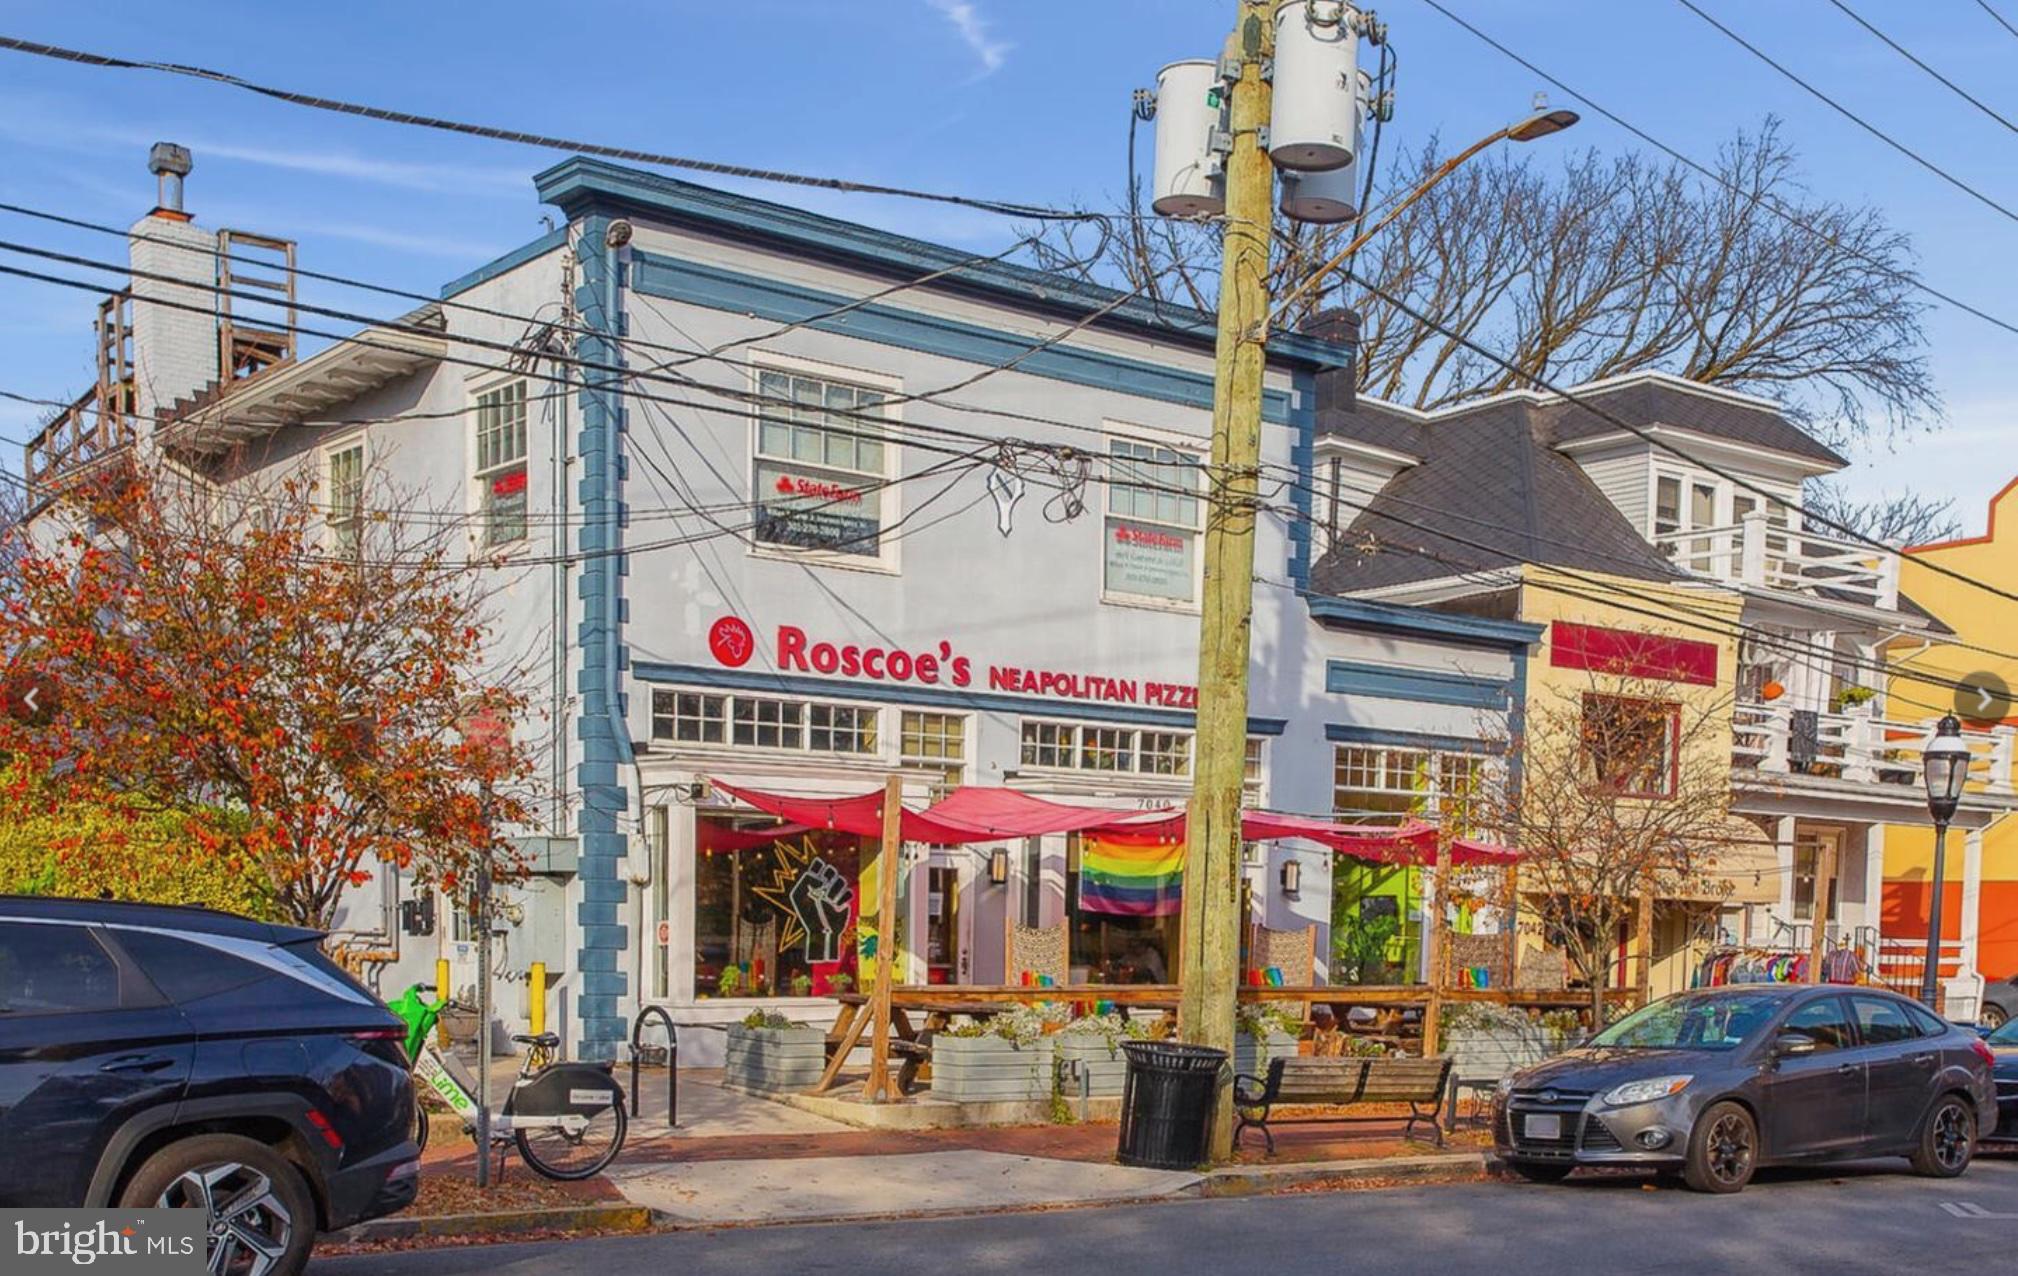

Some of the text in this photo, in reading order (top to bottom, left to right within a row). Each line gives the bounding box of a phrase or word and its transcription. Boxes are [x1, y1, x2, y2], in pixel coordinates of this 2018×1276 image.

[776, 624, 1199, 709] Roscoe's NEAPOLITAN PIZZ
[1137, 798, 1171, 810] 7040
[1517, 920, 1543, 936] 7042
